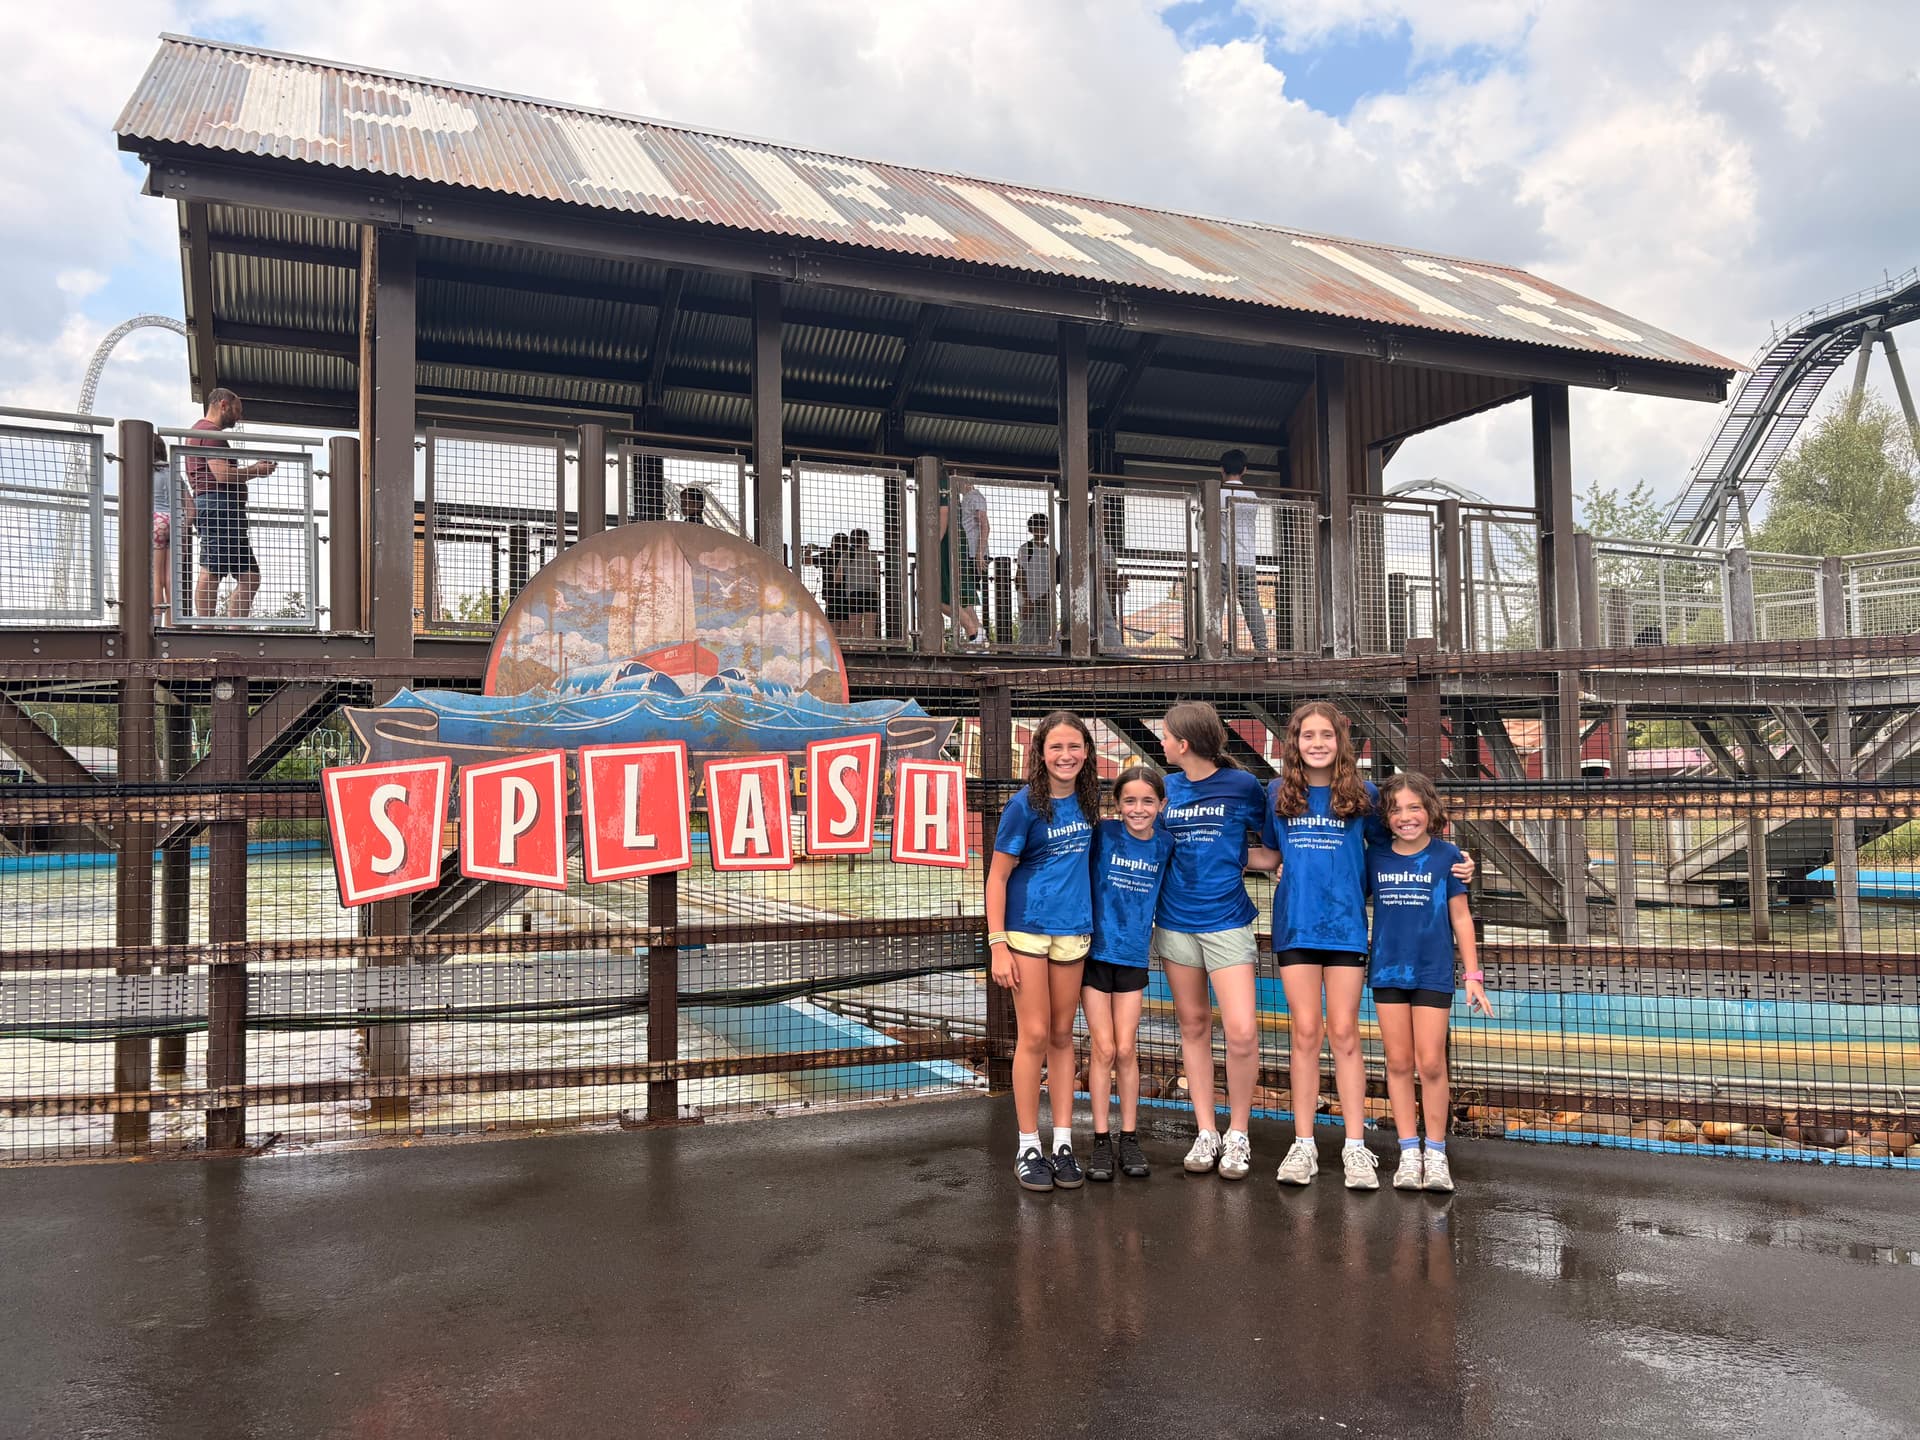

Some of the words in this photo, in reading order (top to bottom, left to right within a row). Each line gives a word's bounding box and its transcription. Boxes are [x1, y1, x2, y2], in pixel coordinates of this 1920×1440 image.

[205, 57, 1238, 284] PIER
[1290, 239, 1644, 343] 13
[369, 753, 952, 875] SPLASH
[1166, 804, 1225, 821] inspired
[1111, 853, 1160, 873] inspired
[1377, 870, 1432, 885] inspired
